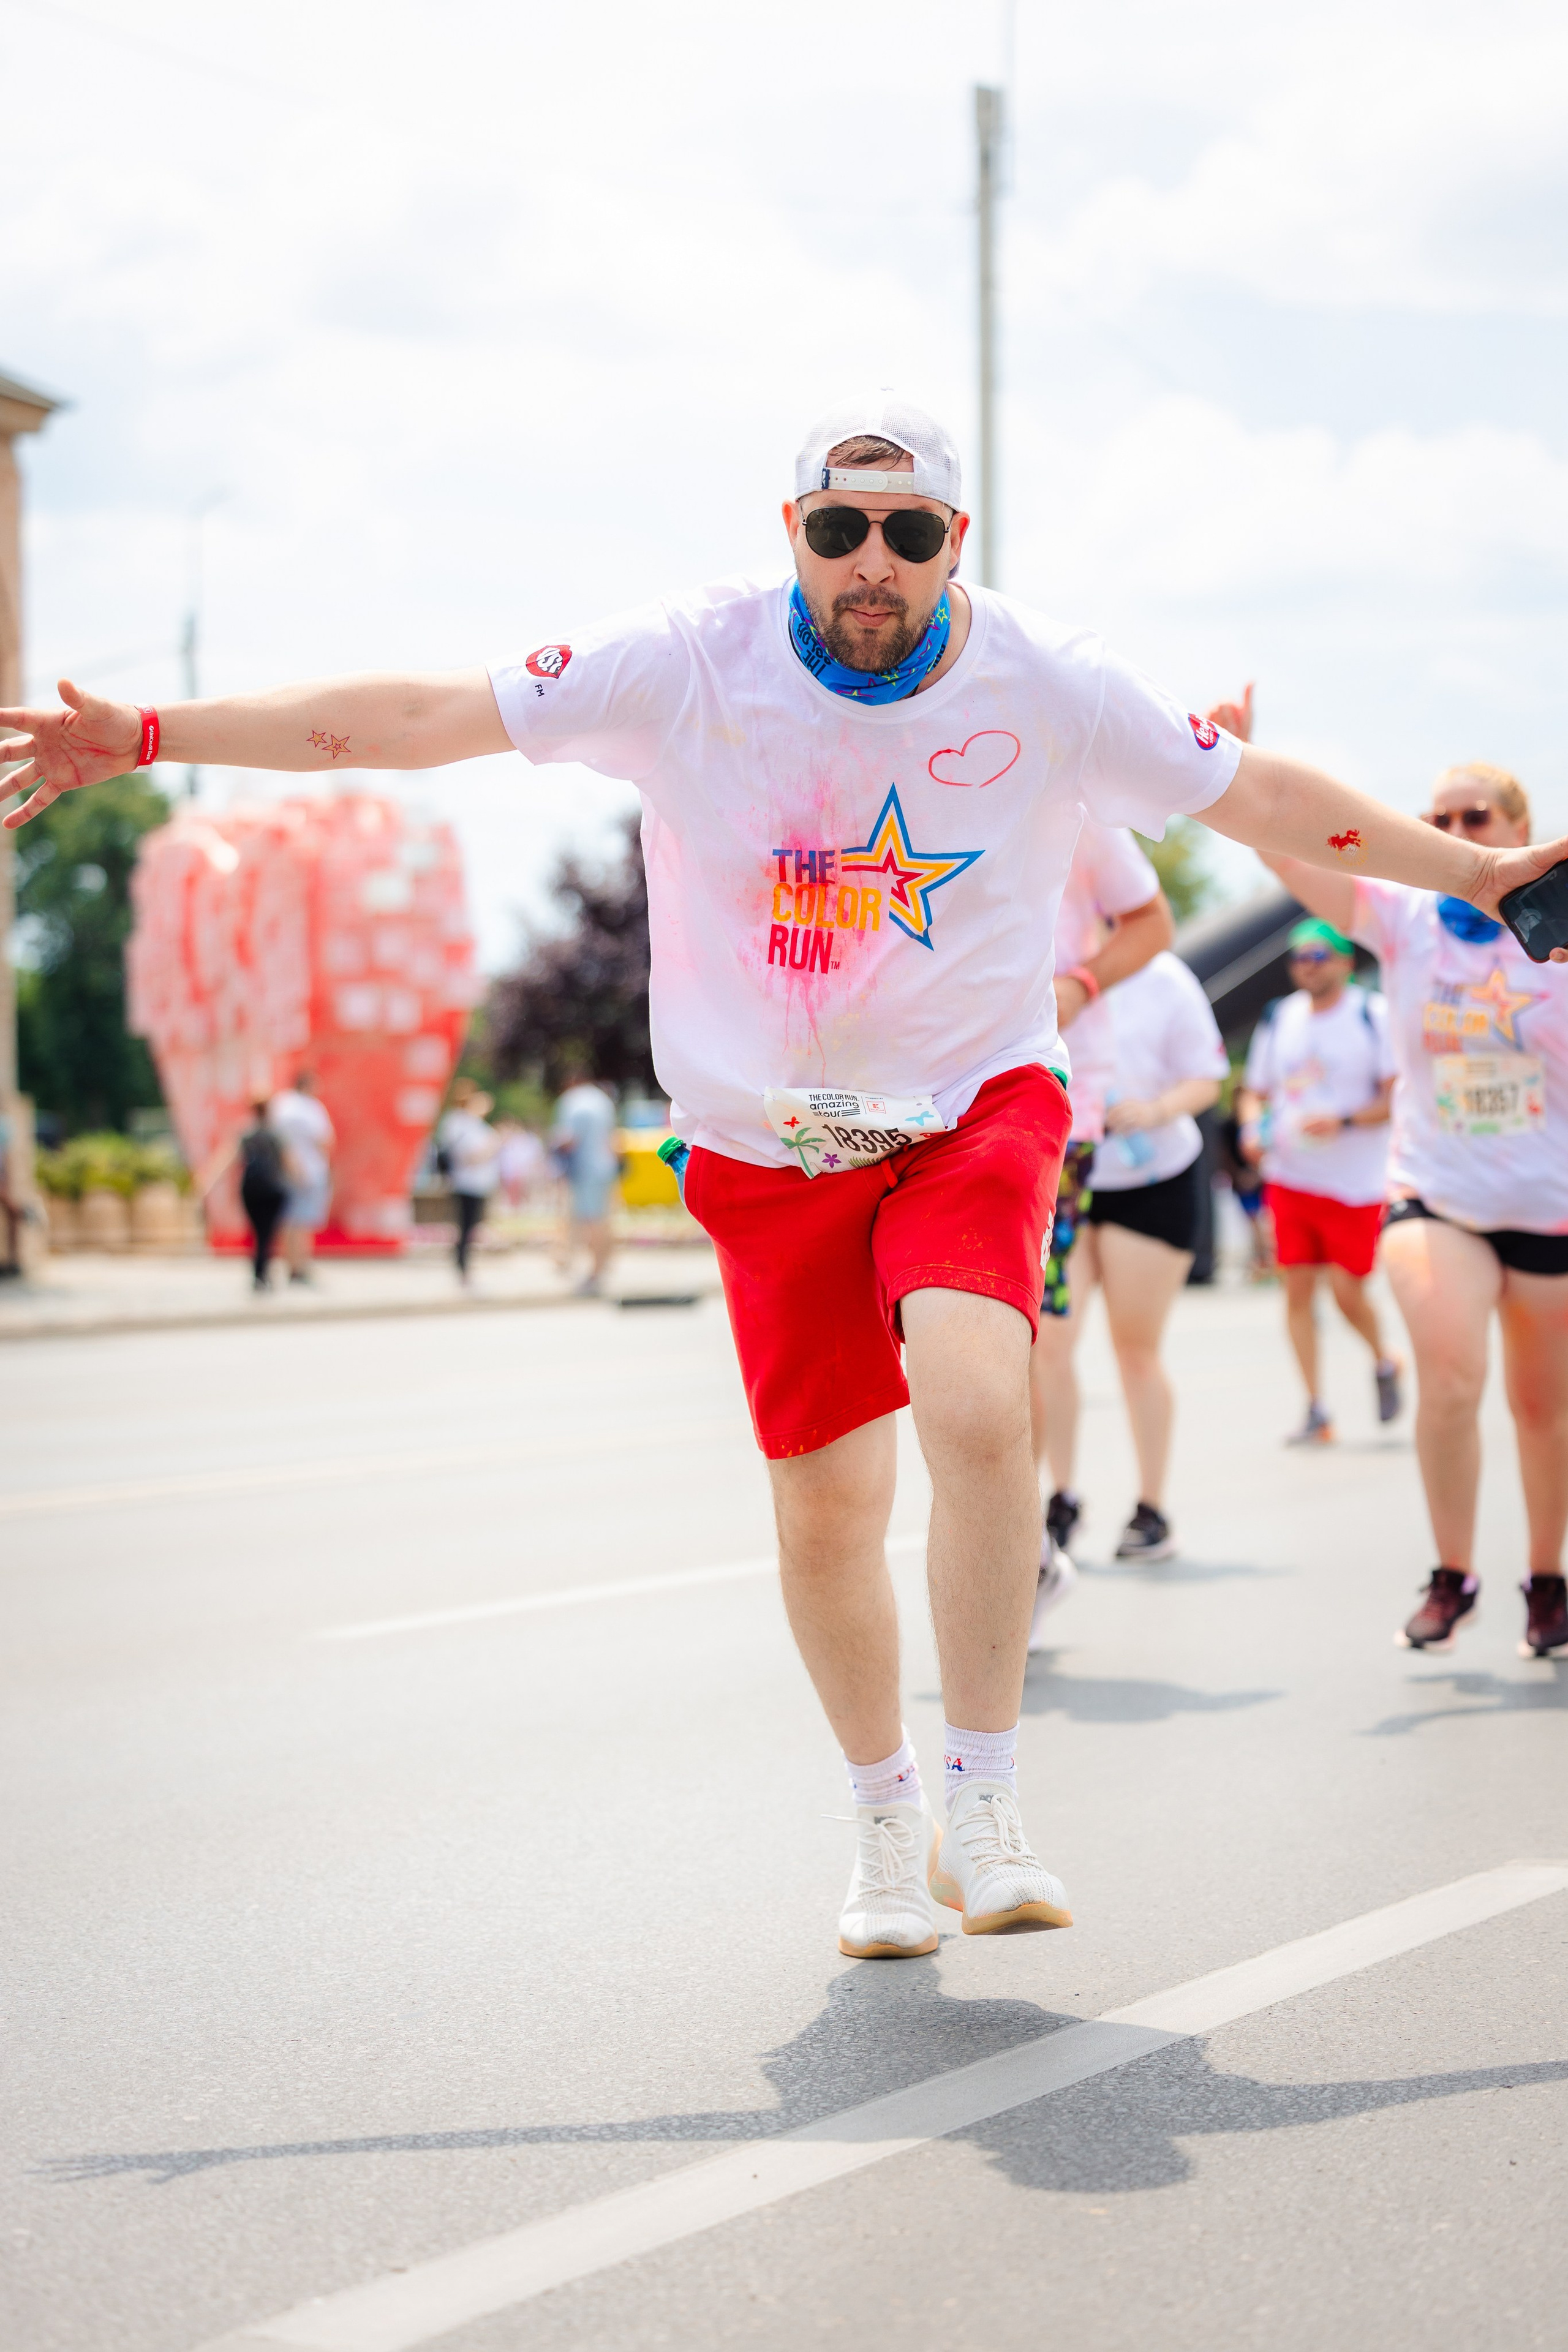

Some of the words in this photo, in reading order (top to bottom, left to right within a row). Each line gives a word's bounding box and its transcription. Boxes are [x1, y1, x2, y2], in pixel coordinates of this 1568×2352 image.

[535, 684, 545, 696] FM
[772, 849, 835, 884] THE
[772, 883, 882, 931] COLOR
[767, 924, 833, 974] RUN
[810, 1100, 859, 1110] amazing
[821, 1123, 912, 1154] 18395
